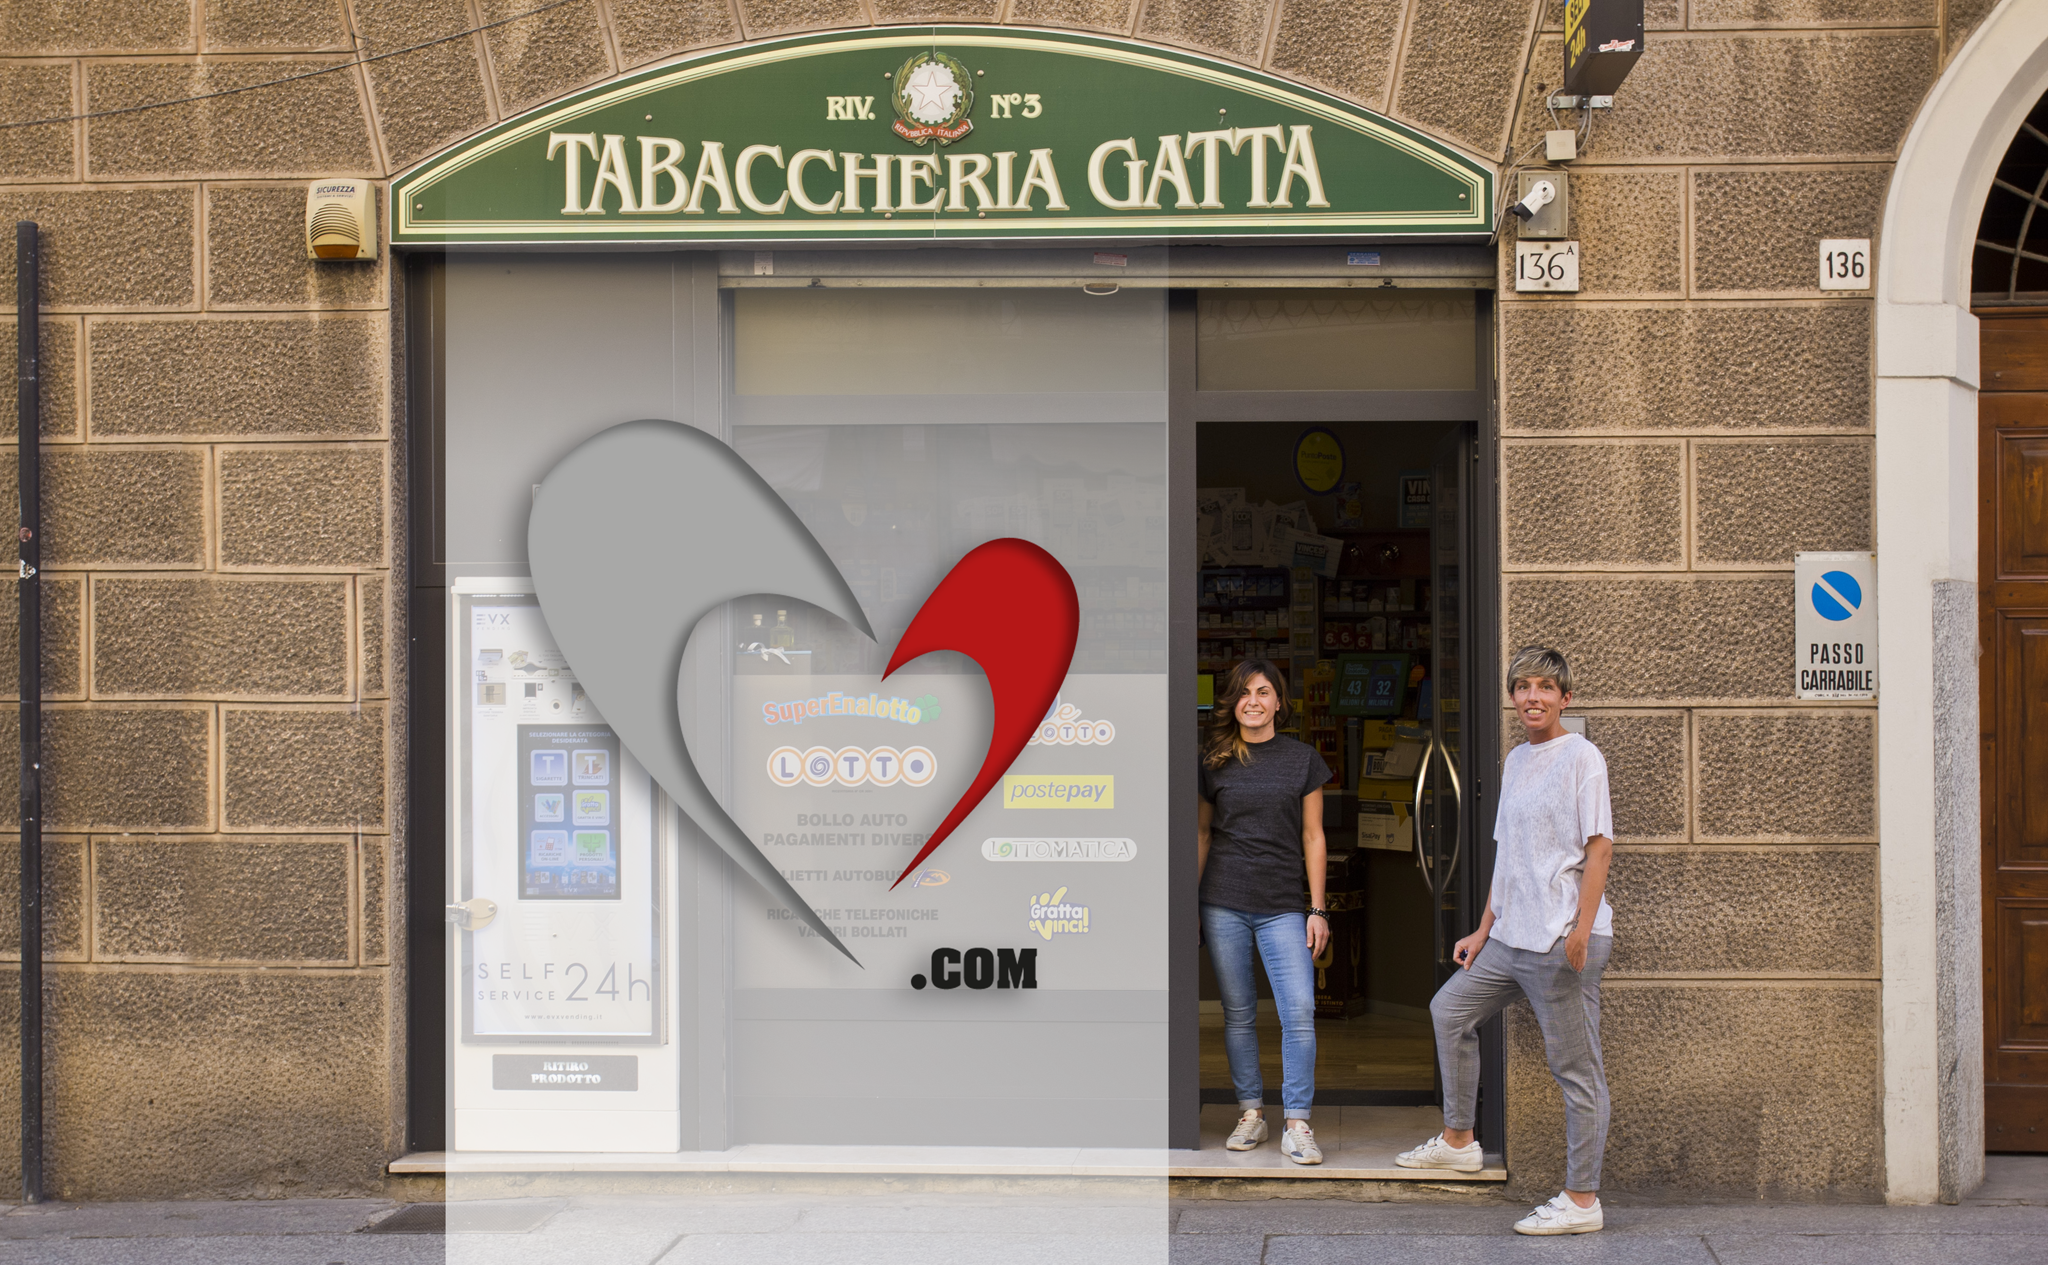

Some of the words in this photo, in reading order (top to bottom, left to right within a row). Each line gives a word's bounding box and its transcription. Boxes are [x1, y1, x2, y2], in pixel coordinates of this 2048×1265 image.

[1570, 25, 1586, 68] 24h
[826, 95, 876, 121] RIV.
[894, 123, 933, 137] REPVBBLICA
[937, 125, 969, 137] ITALIANA
[547, 132, 1070, 215] TABACCHERIA
[1087, 124, 1331, 210] GATTA
[316, 185, 355, 194] SICUREZZA
[1826, 251, 1864, 278] 136
[1407, 480, 1430, 494] VIN
[1810, 643, 1864, 664] PASSO
[1347, 681, 1362, 695] 43
[1376, 681, 1391, 695] 32
[1801, 670, 1873, 691] CARRABILE
[763, 692, 922, 725] SuperEnalotto
[774, 750, 932, 782] LOTTO
[1010, 782, 1107, 802] postepay
[797, 814, 854, 826] BOLLO
[860, 814, 907, 826] AUTO
[763, 833, 865, 846] PAGAMENTI
[989, 841, 1129, 858] LOTTOMATICA
[845, 909, 939, 920] TELEFONICHE
[1031, 903, 1082, 919] Gratta
[852, 926, 907, 937] BOLLATI
[478, 963, 555, 979] SELF
[565, 961, 650, 1001] 24h
[478, 991, 555, 1000] SERVICE
[524, 1013, 603, 1021] www.evxvending.it
[543, 1061, 588, 1071] RITIRO
[531, 1073, 601, 1084] PRODOTTO
